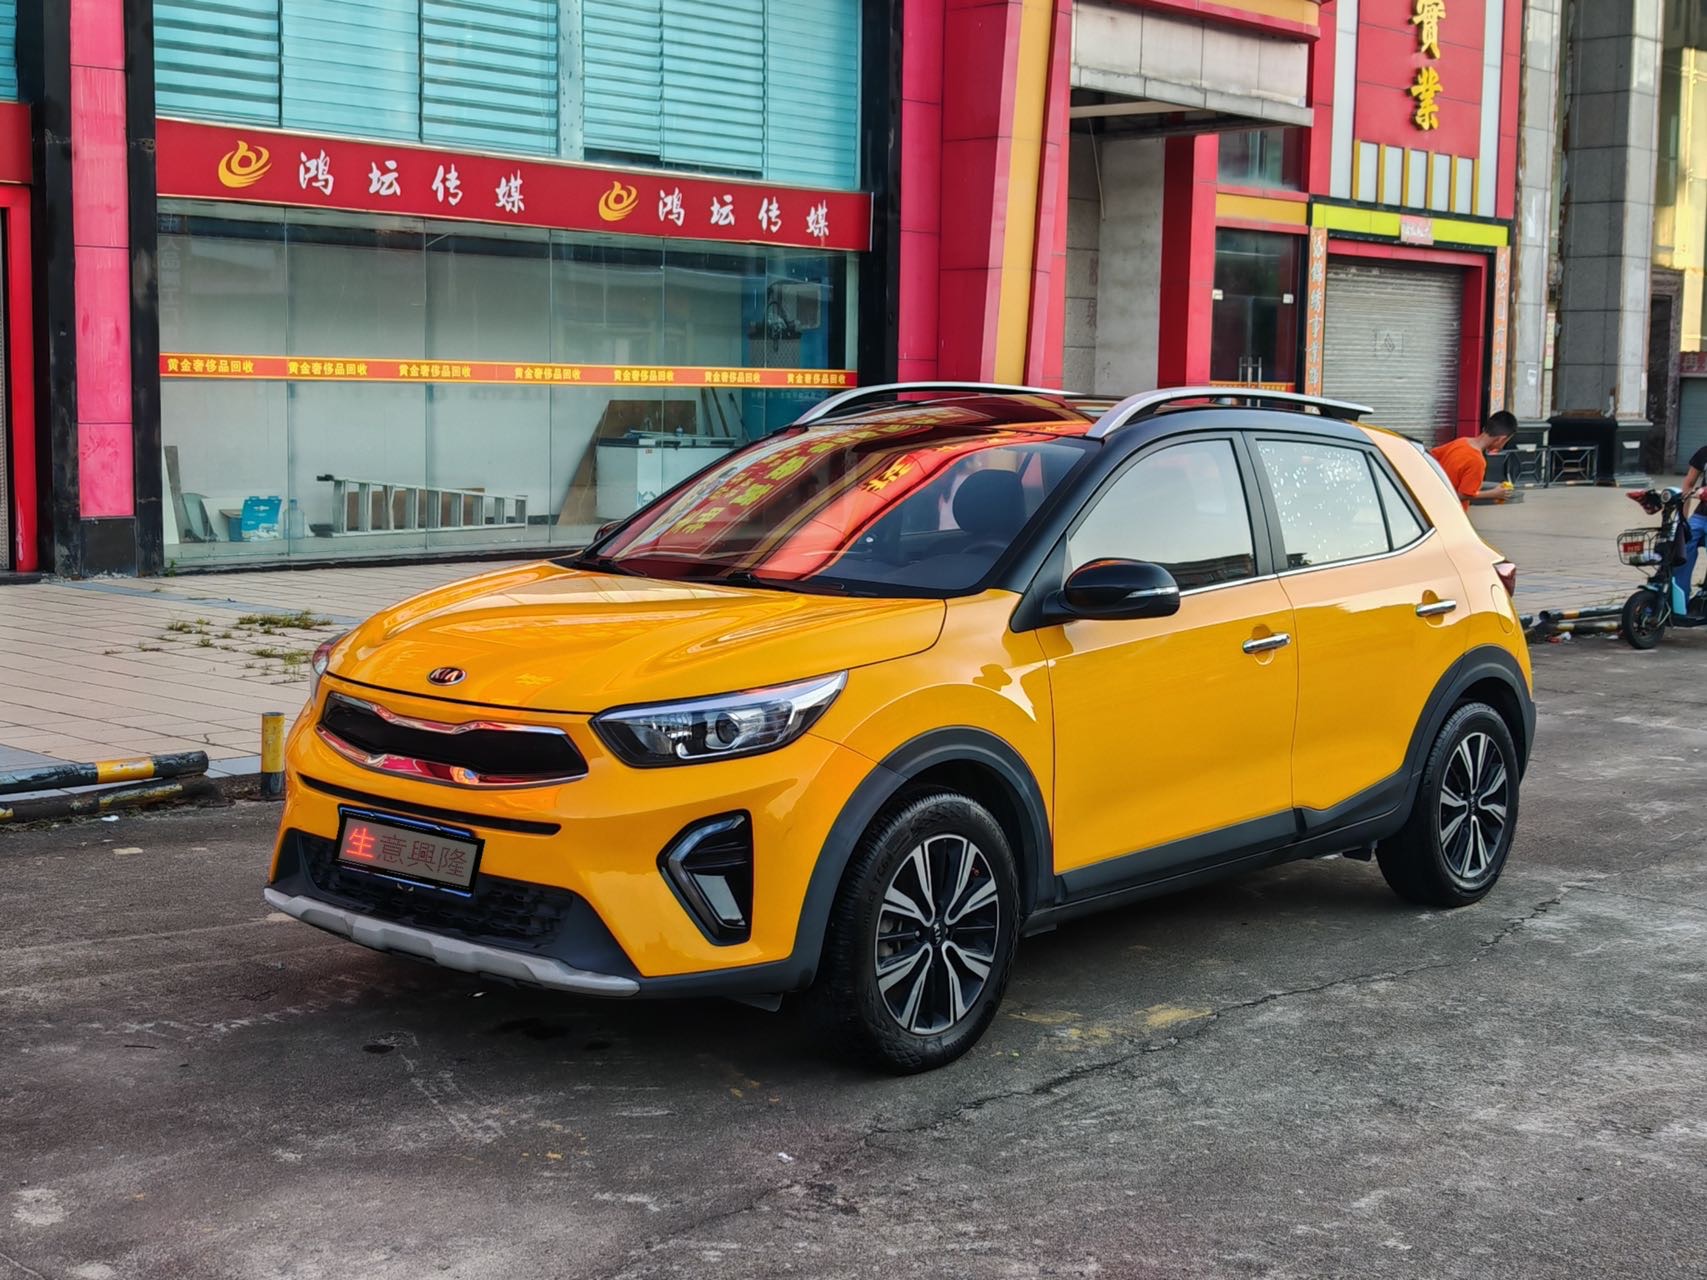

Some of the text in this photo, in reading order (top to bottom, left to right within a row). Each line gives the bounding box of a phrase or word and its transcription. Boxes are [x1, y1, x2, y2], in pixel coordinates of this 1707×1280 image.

[299, 149, 525, 213] 鸿坛传媒
[658, 187, 830, 237] 鸿坛传媒
[167, 358, 254, 373] 黄金奢侈品回收
[288, 361, 368, 376] 黄金奢侈品回收
[399, 363, 471, 378] 黄金奢侈品回收
[514, 367, 581, 380] 黄金奢侈品回收
[613, 369, 674, 382] 黄金奢侈品回收
[346, 827, 467, 877] 生意興隆
